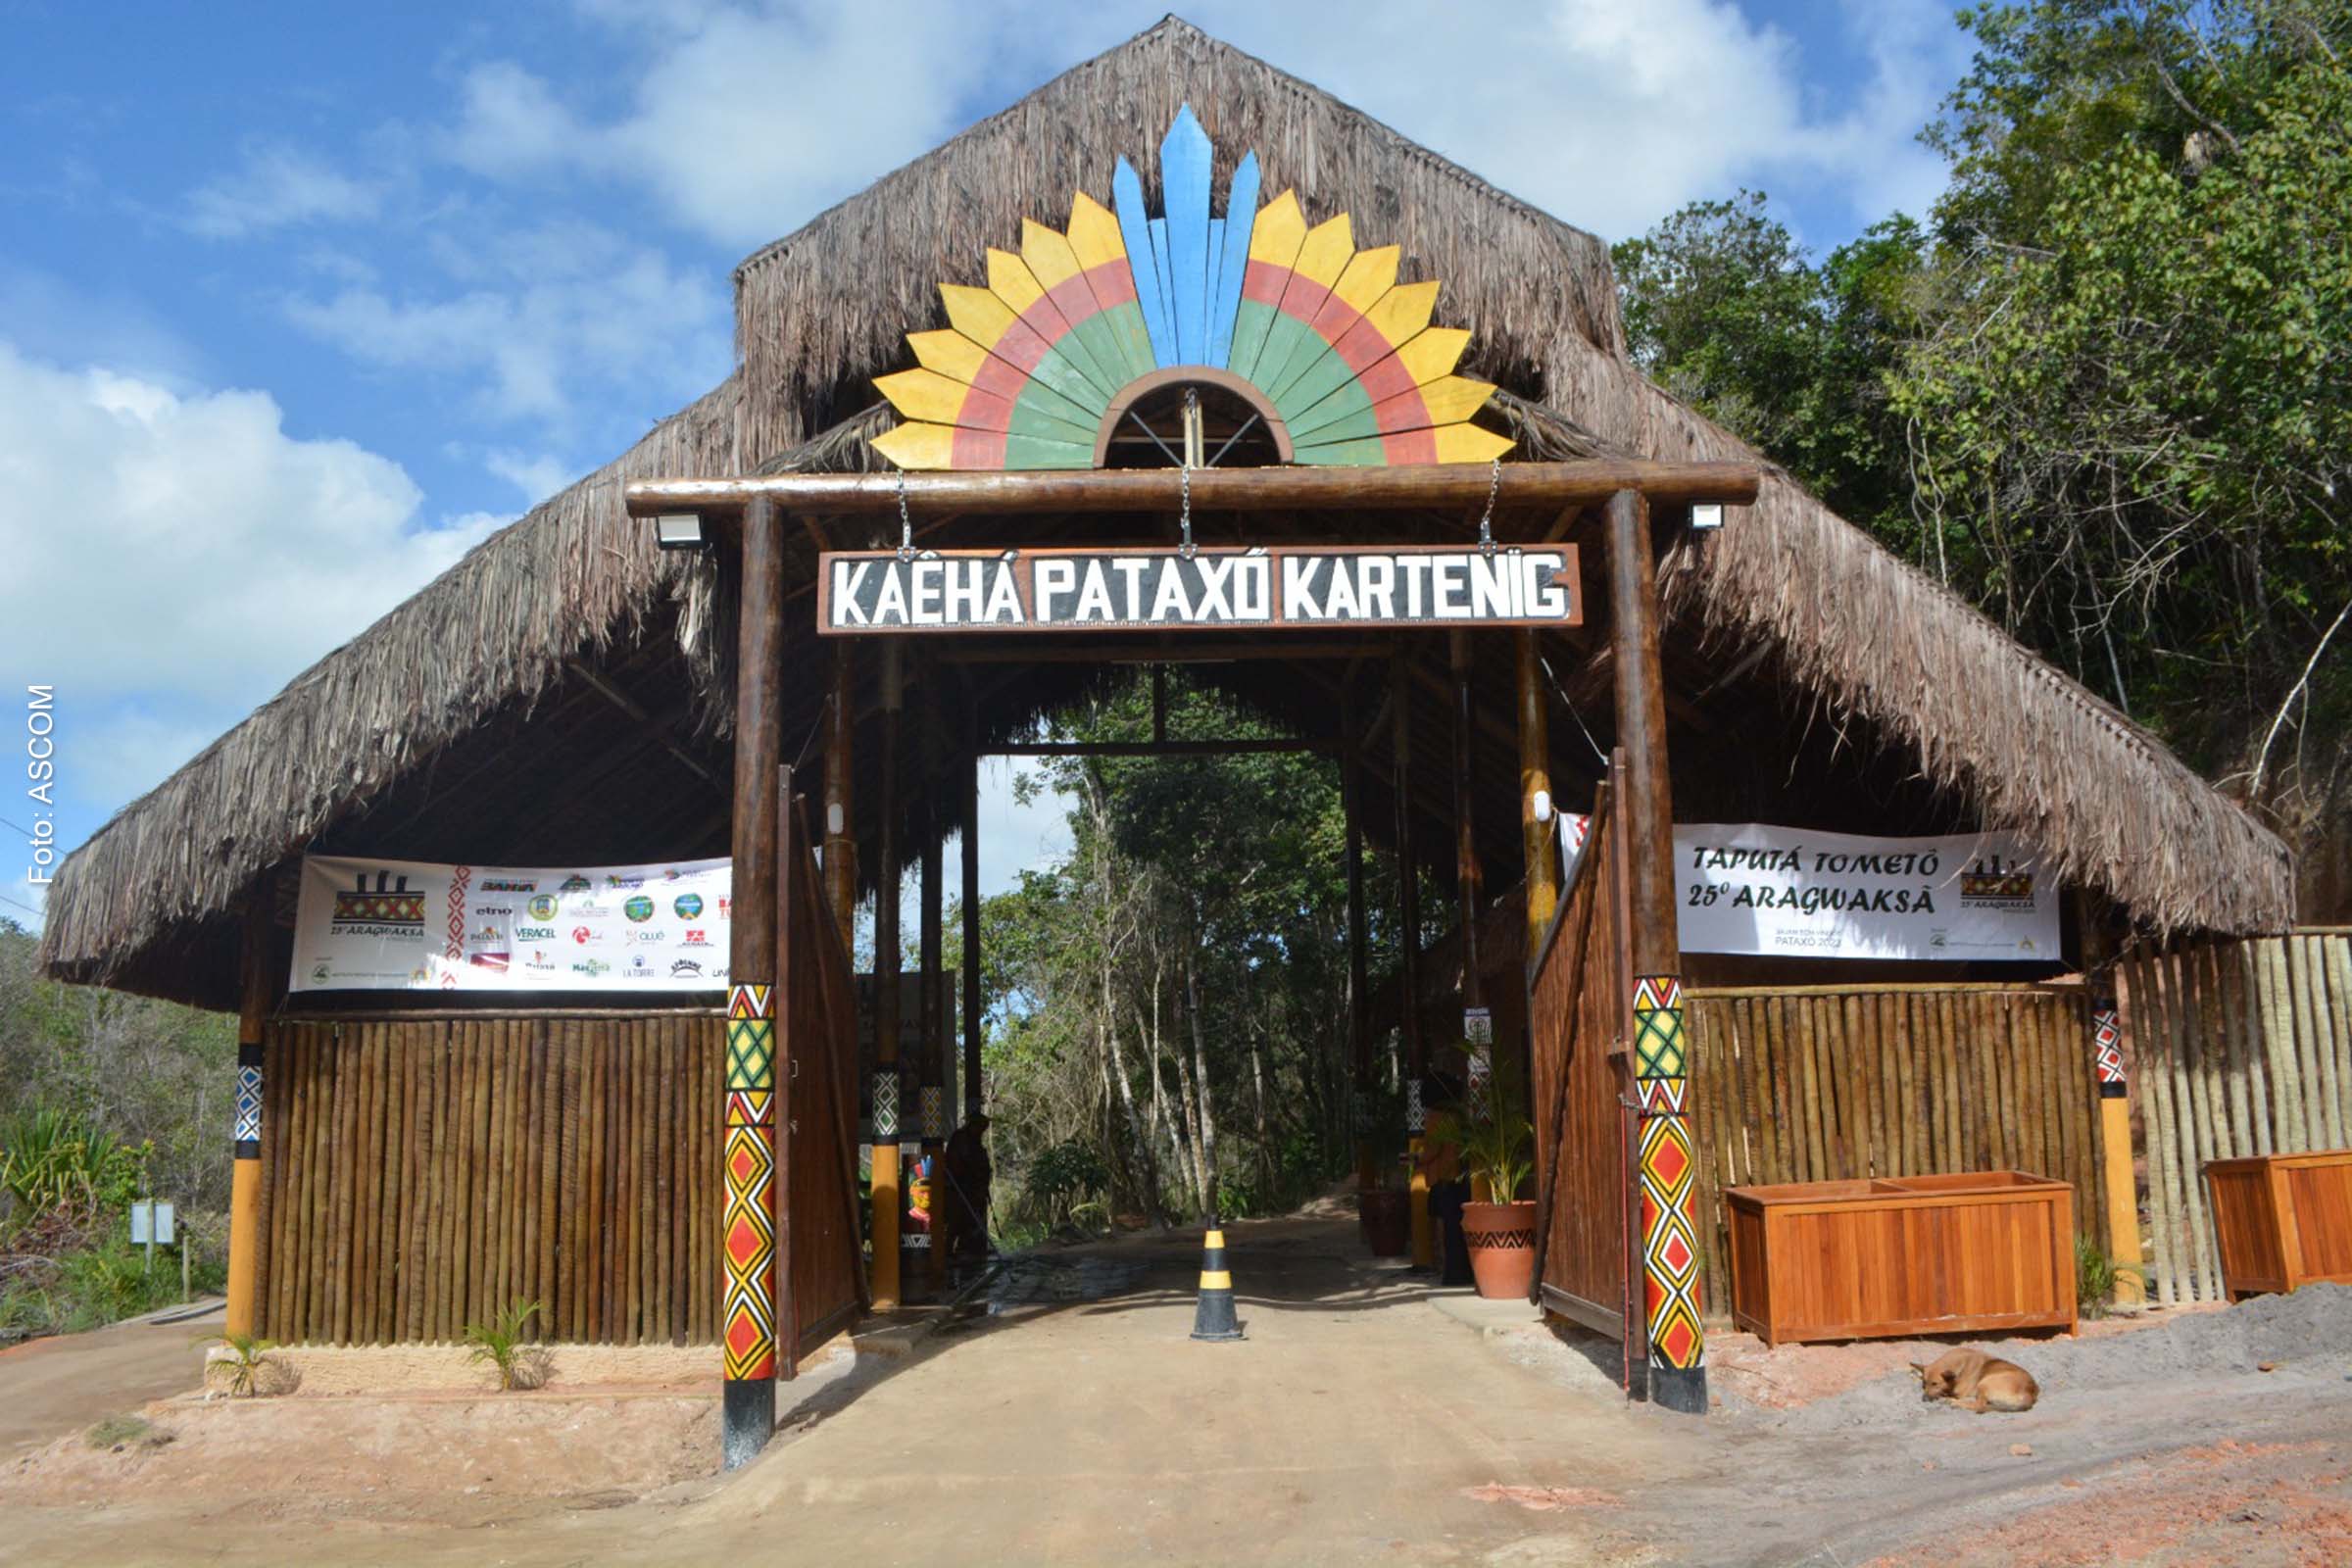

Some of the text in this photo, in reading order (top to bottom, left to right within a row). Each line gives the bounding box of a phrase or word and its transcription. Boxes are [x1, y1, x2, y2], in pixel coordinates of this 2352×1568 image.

[1693, 846, 1802, 872] TAPUTÁ
[1733, 885, 1936, 915] ARAGWAKSÃ
[476, 906, 512, 916] etno
[515, 927, 556, 939] VERACEL
